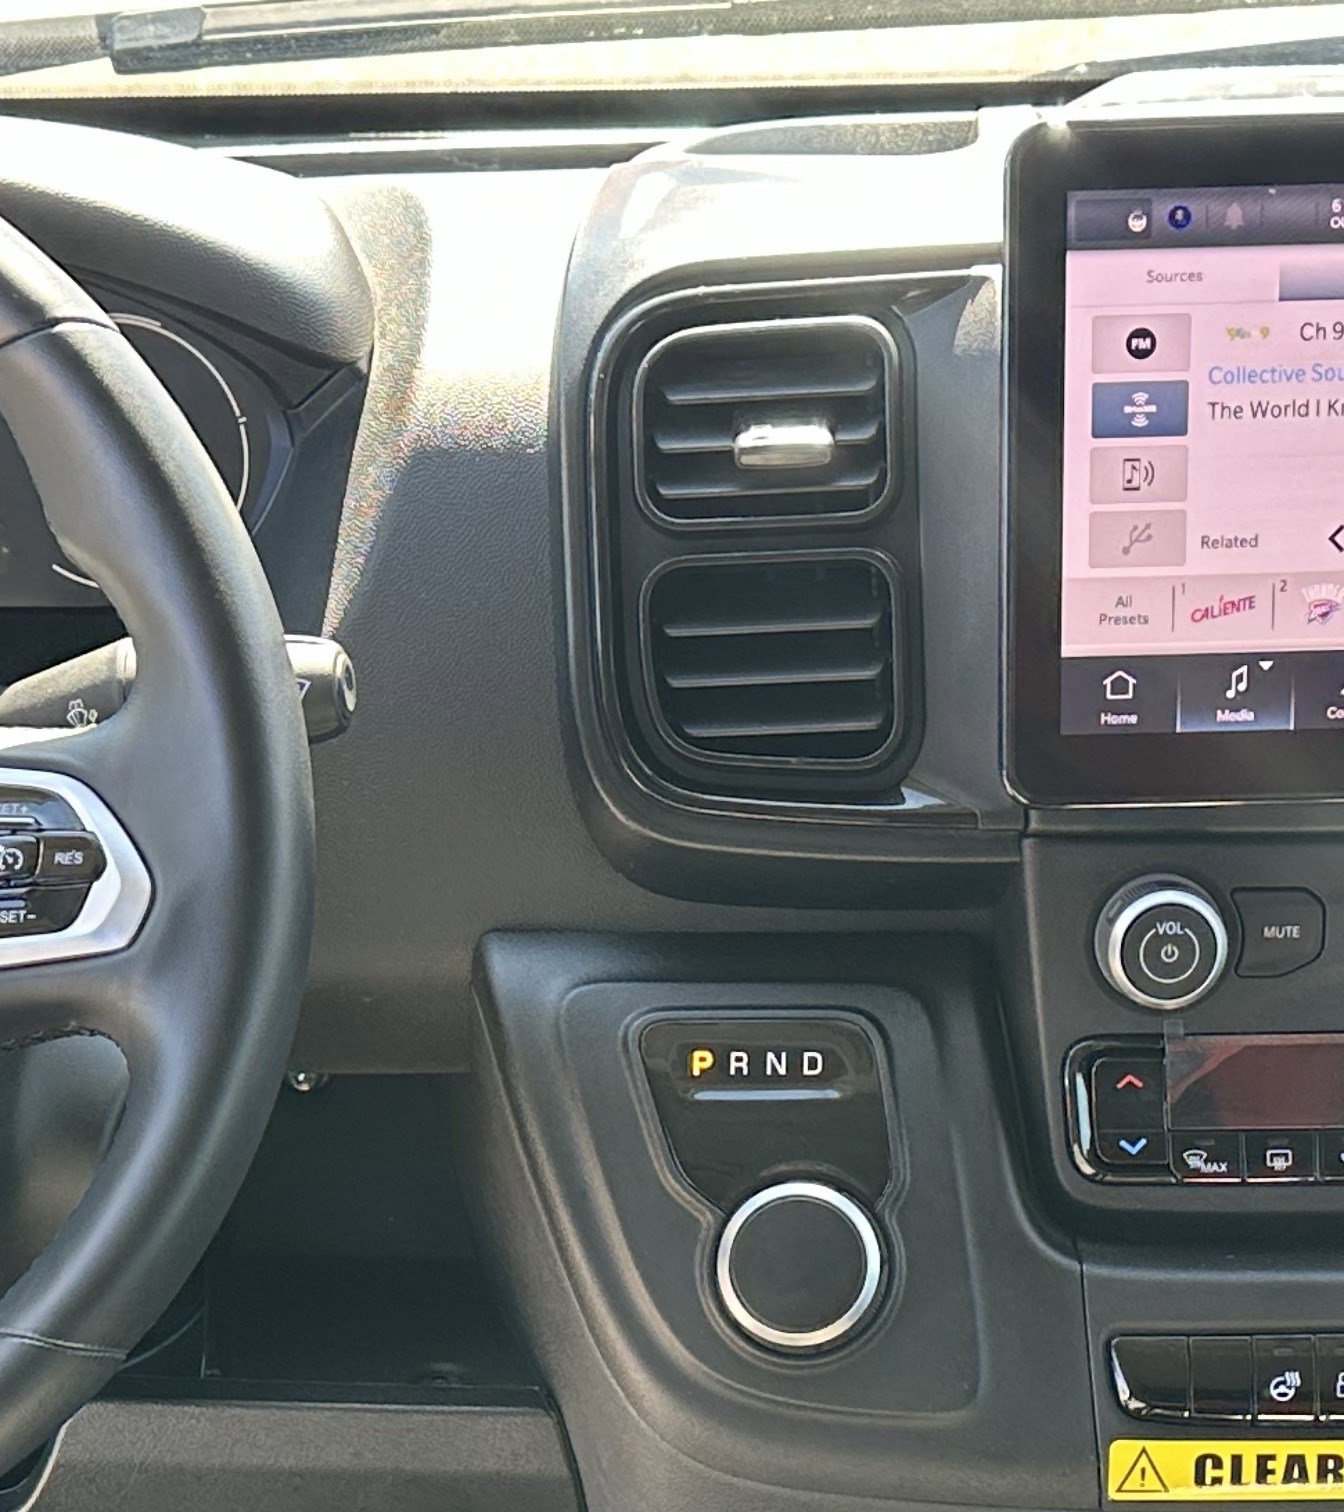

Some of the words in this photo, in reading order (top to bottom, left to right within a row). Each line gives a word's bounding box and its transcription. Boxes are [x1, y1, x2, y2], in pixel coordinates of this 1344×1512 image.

[1146, 269, 1204, 285] Sources
[1299, 322, 1328, 342] Ch
[1129, 337, 1152, 350] FM
[1207, 364, 1307, 386] Collective
[1207, 401, 1244, 421] The
[1249, 398, 1310, 419] World
[1200, 533, 1259, 551] Related
[1279, 579, 1288, 592] 2
[1115, 594, 1133, 609] All
[1098, 612, 1150, 628] Presets
[1099, 711, 1138, 726] Home
[1216, 708, 1255, 724] Media
[54, 851, 85, 866] RES
[1155, 922, 1185, 936] VOL
[1263, 924, 1301, 939] MUTE
[691, 1050, 714, 1076] P
[729, 1050, 750, 1077] R
[765, 1050, 788, 1077] N
[802, 1050, 825, 1077] D
[1200, 1160, 1228, 1174] MAX
